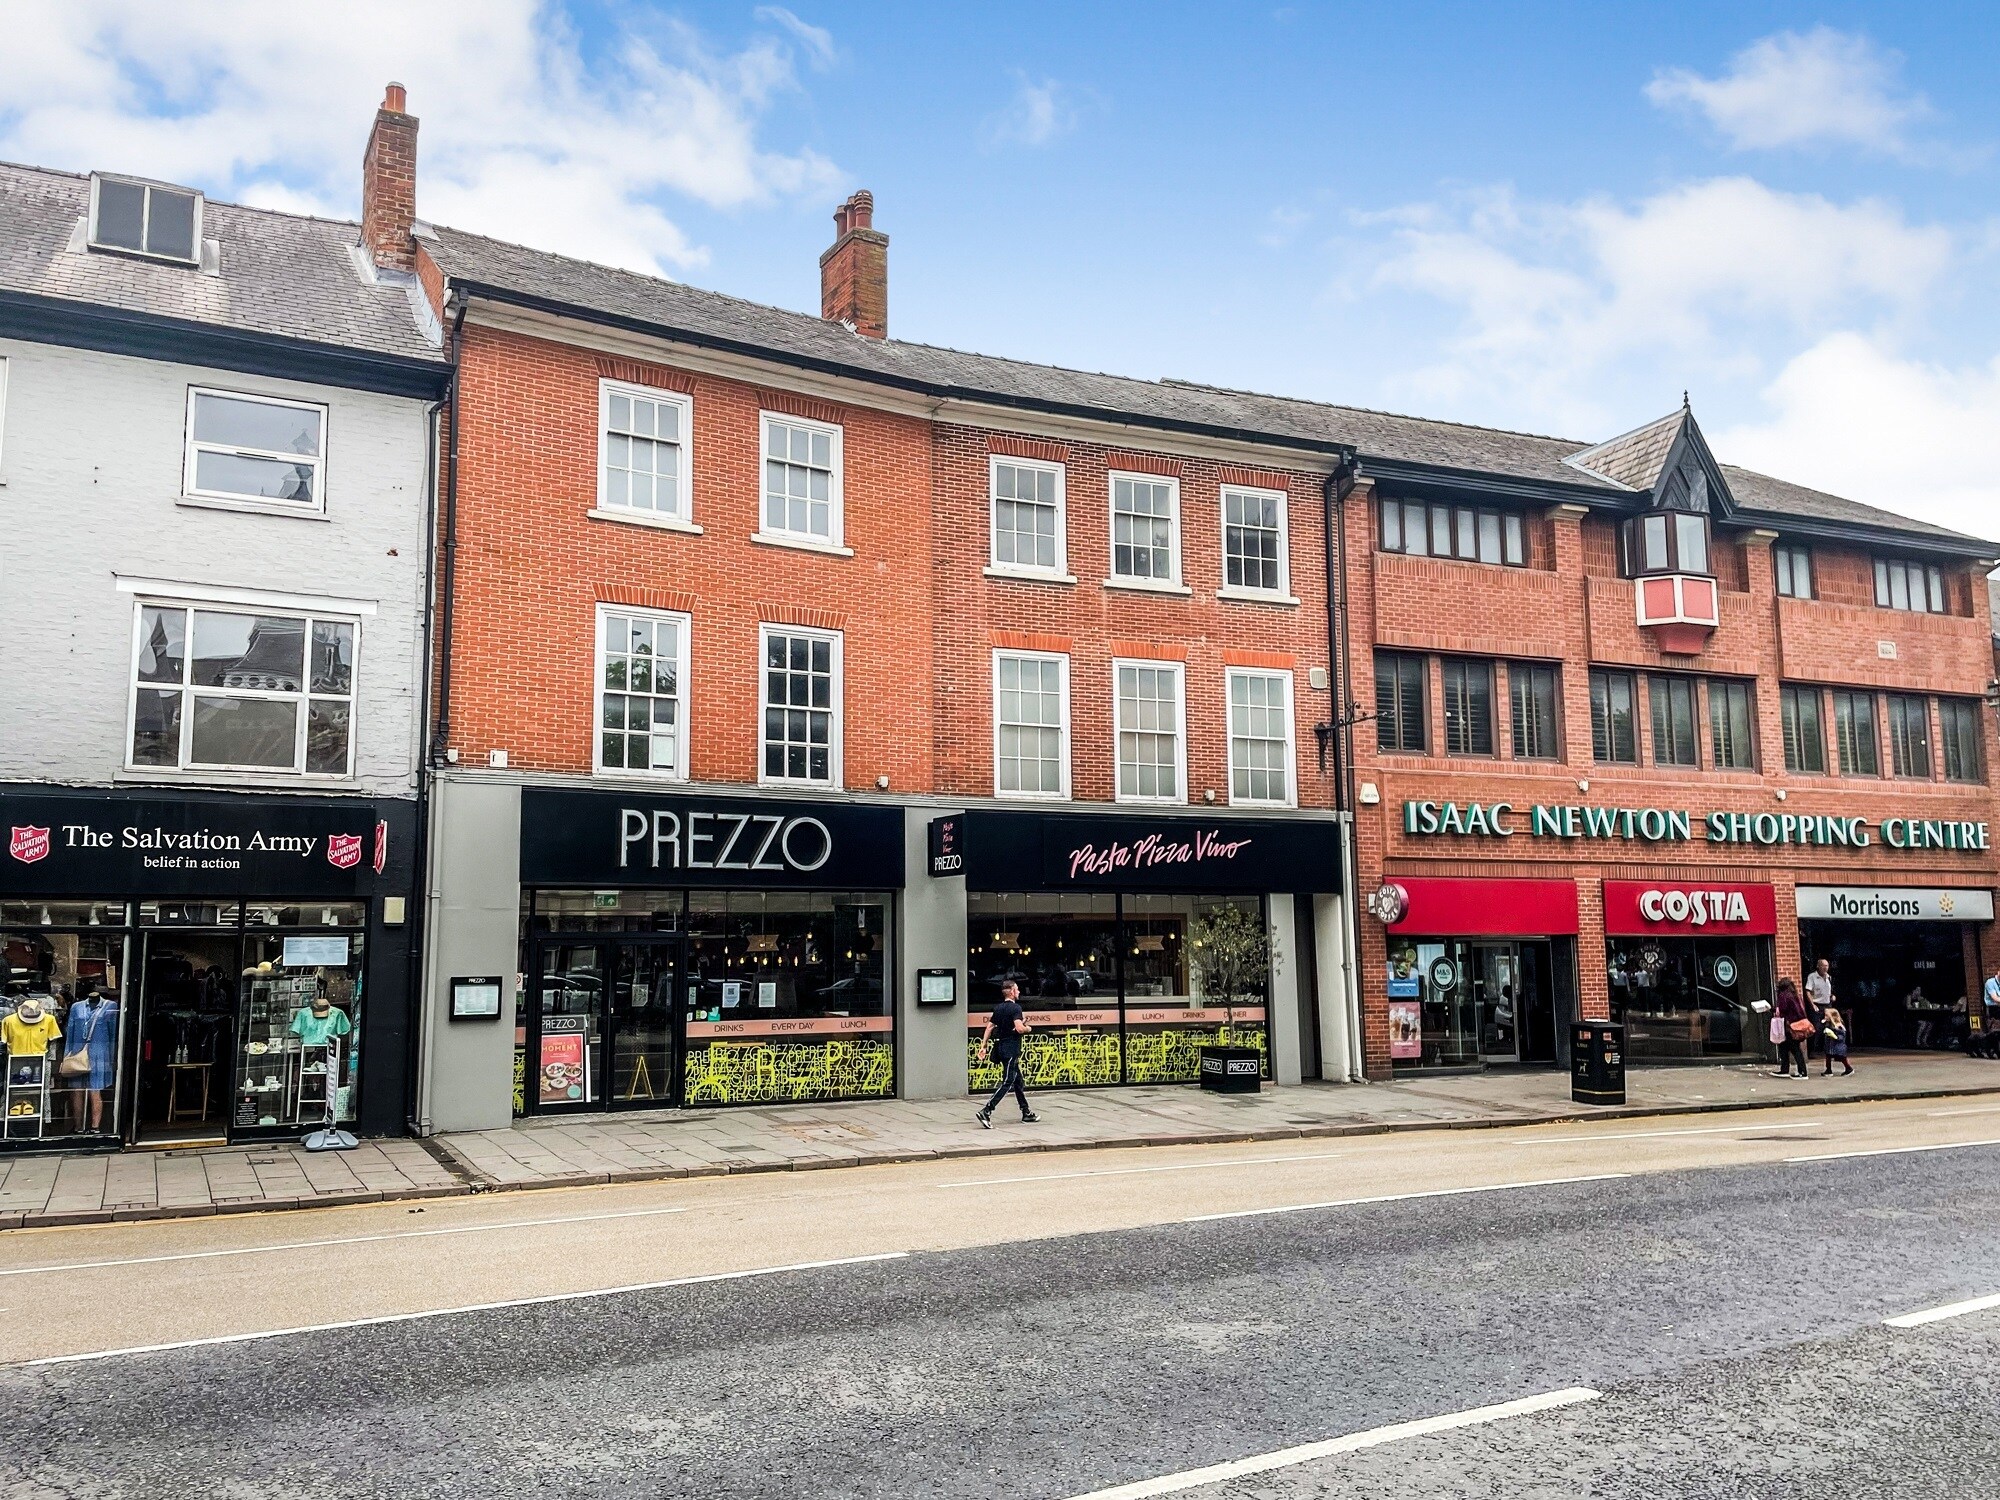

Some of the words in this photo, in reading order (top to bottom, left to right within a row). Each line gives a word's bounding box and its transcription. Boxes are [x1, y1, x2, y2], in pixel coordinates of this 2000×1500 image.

[1404, 801, 1513, 835] ISAAC
[1532, 805, 1691, 840] NEWTON
[1706, 812, 1870, 847] SHOPPING
[1881, 819, 1991, 850] CENTRE
[19, 830, 33, 840] THE
[62, 825, 114, 847] The
[122, 827, 241, 850] Salvation
[247, 831, 318, 857] Army
[619, 808, 832, 871] PREZZO
[12, 832, 49, 853] SALVATION
[335, 839, 348, 848] THE
[23, 844, 45, 859] ARMY
[328, 841, 361, 860] SALVATION
[339, 851, 358, 864] ARMY
[1069, 842, 1132, 879] Pasta
[1133, 834, 1193, 868] Pizza
[1196, 830, 1252, 861] Vino
[143, 856, 184, 868] belief
[185, 857, 199, 868] in
[201, 858, 241, 869] action
[934, 854, 962, 870] PREZZO
[1380, 887, 1396, 898] COSTA
[1640, 890, 1750, 925] COSTA
[1830, 894, 1920, 916] Morrisons
[1066, 1013, 1087, 1021] EVERY
[1089, 1013, 1103, 1021] DAY
[1142, 1013, 1165, 1021] LUNCH
[1182, 1011, 1206, 1020] DRINKS
[714, 1024, 744, 1033] DRINKS
[771, 1020, 796, 1031] EVERY
[798, 1021, 815, 1030] DAY
[840, 1020, 867, 1029] LUNCH
[1203, 1059, 1222, 1071] PREZZO
[1230, 1062, 1256, 1072] PREZZO
